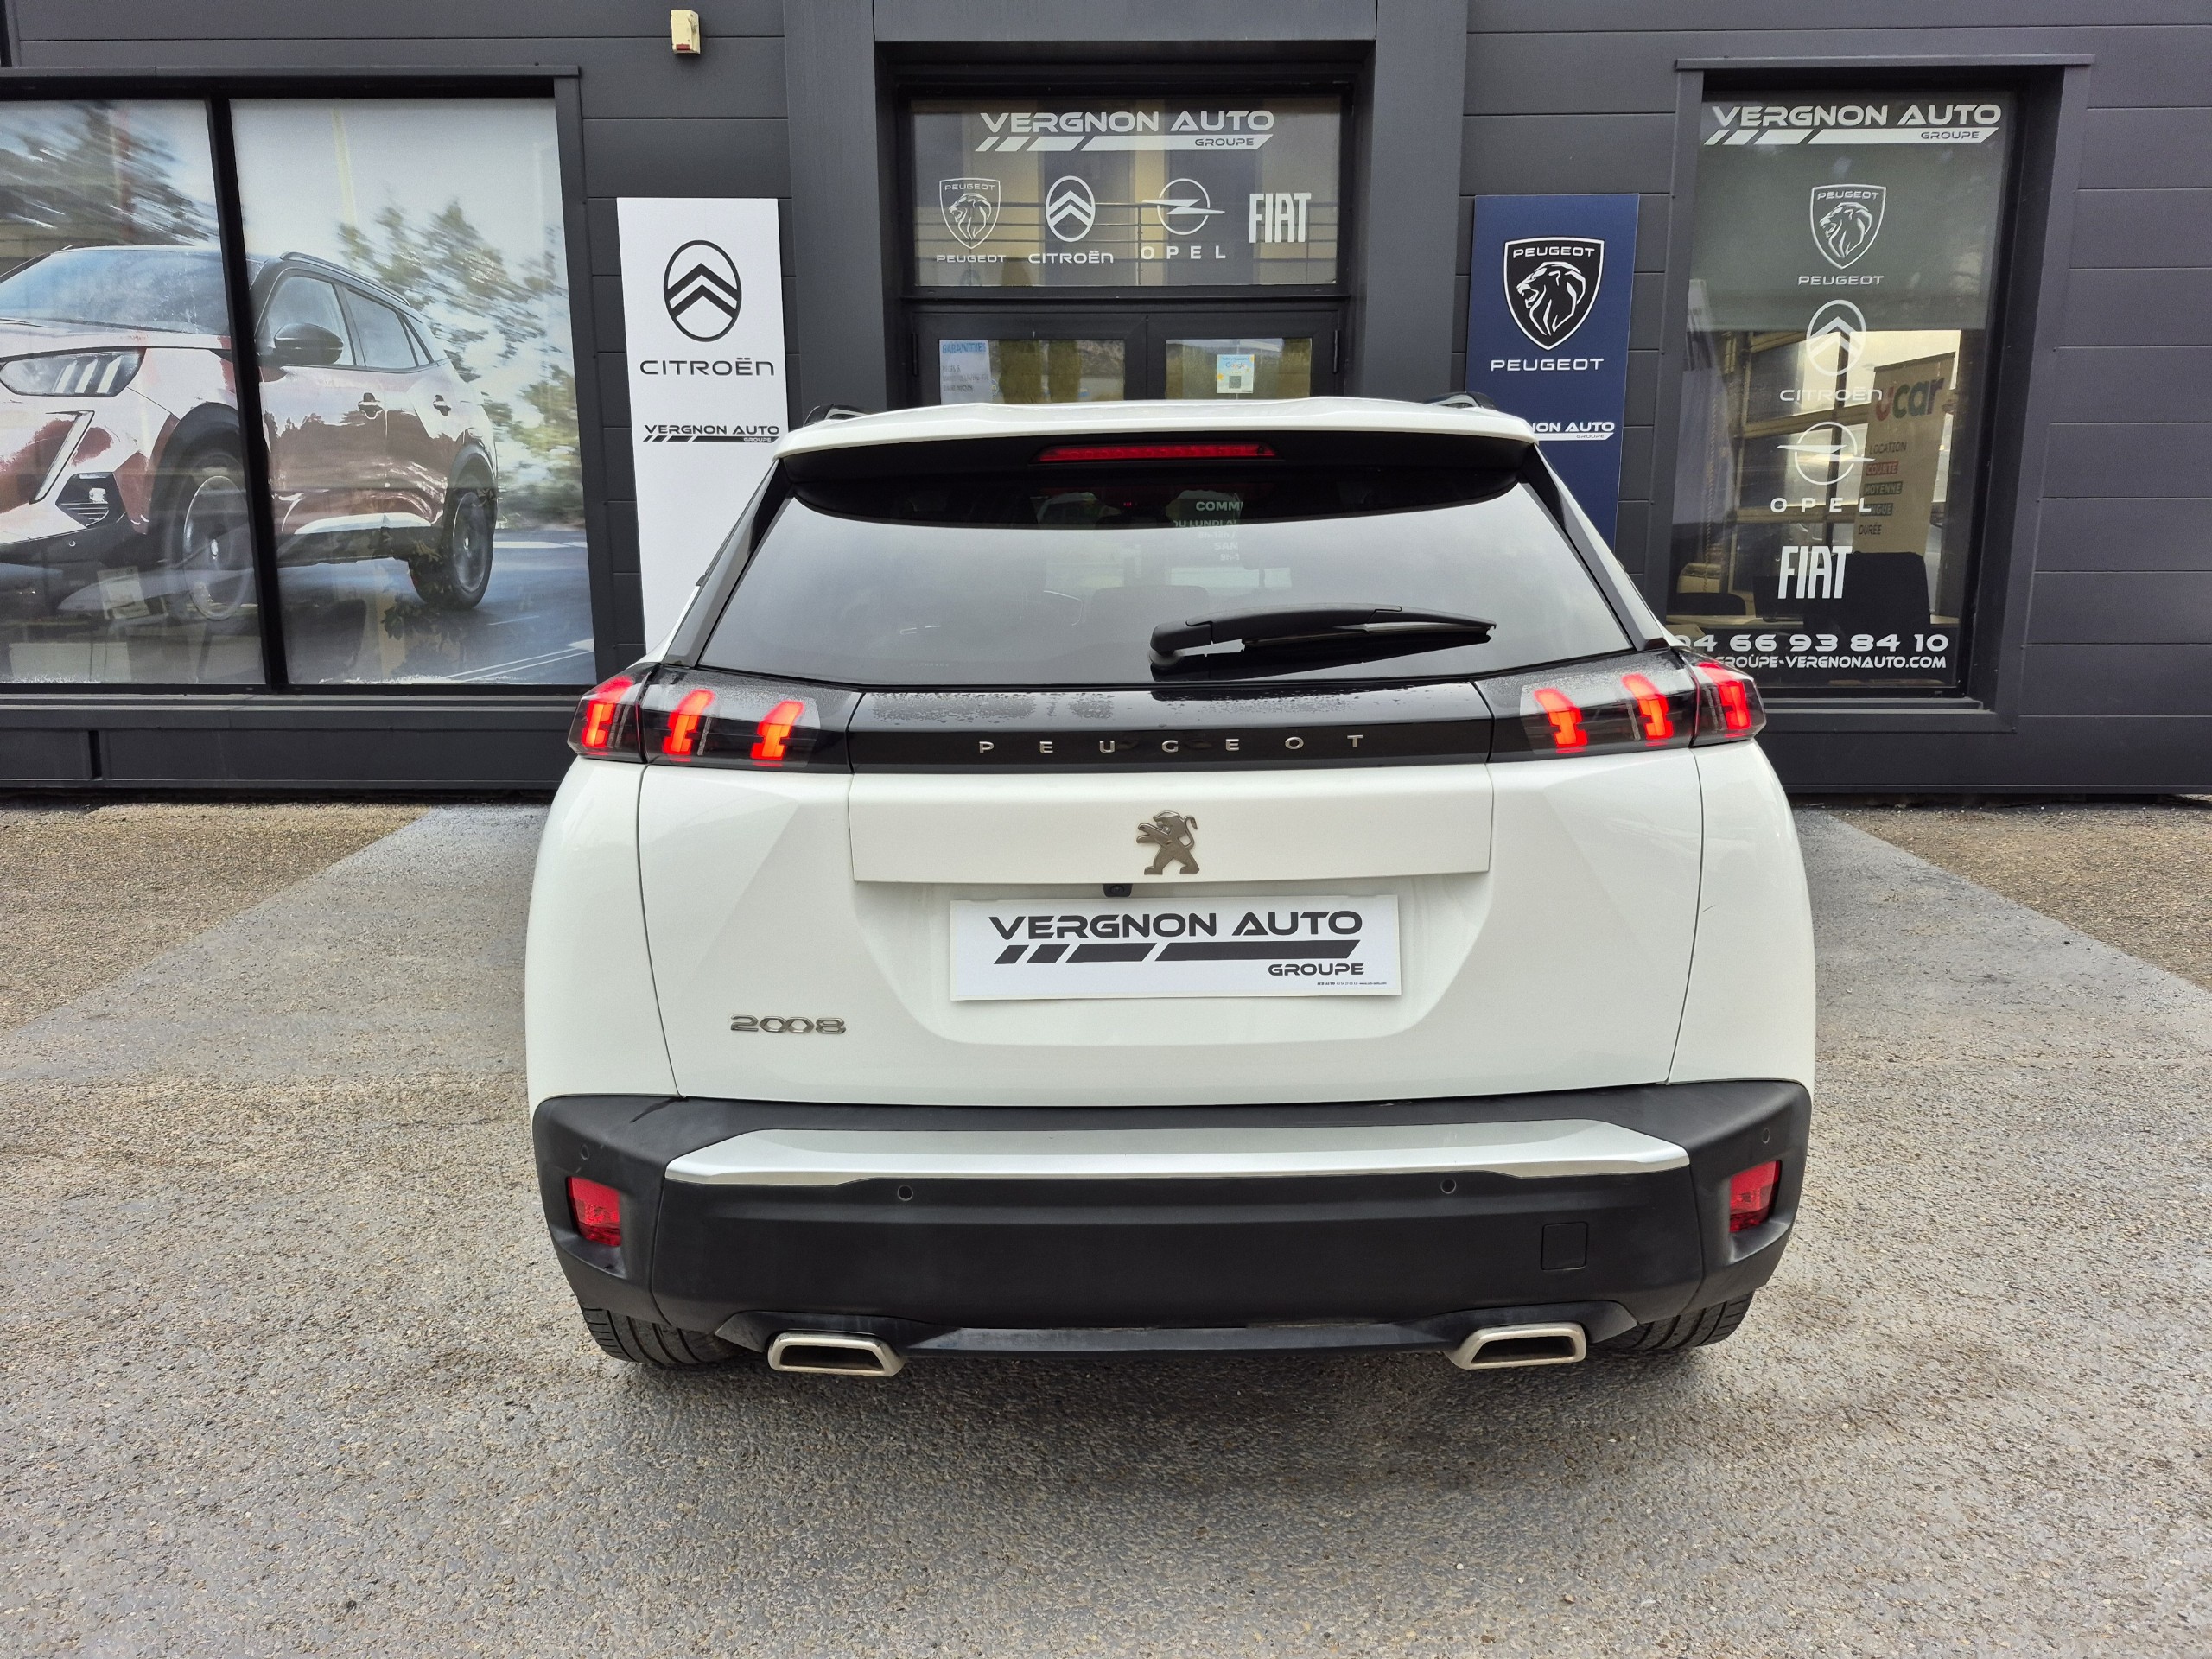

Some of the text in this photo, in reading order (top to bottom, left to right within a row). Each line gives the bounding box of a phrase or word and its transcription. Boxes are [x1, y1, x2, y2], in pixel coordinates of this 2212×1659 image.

[980, 110, 1274, 133] VERGNON AUTO
[1713, 104, 2002, 127] VERGNON AUTO
[1920, 130, 1980, 139] GROUPE
[1195, 137, 1255, 146] GROUPE
[1817, 190, 1879, 200] PEUGEOT
[1249, 192, 1312, 244] FIAT
[936, 254, 1007, 263] PEUGEOT
[1141, 245, 1226, 259] OPEL
[1512, 246, 1595, 258] PEUGEOT
[1798, 275, 1884, 285] PEUGEOT
[639, 357, 775, 376] CITROËN
[1491, 358, 1605, 372] PEUGEOT
[1876, 378, 1945, 422] ucar
[644, 424, 780, 435] VERGNON AUTO
[1565, 421, 1615, 432] AUTO
[1869, 441, 1907, 454] LOCATION
[1866, 462, 1898, 475] COURTE
[1864, 482, 1902, 495] MOYENNE
[1770, 496, 1872, 513] OPEL
[1859, 523, 1882, 535] DURÉE
[1777, 545, 1853, 599] FIAT
[1729, 634, 1777, 652] 66
[1789, 634, 1838, 652] 93
[1850, 634, 1900, 652] 84
[1915, 634, 1949, 652] 10
[978, 734, 1363, 754] PEUGEOT
[988, 911, 1363, 940] VERGNON AUTO
[1268, 963, 1364, 976] GROUPE
[731, 1014, 847, 1034] 2008
